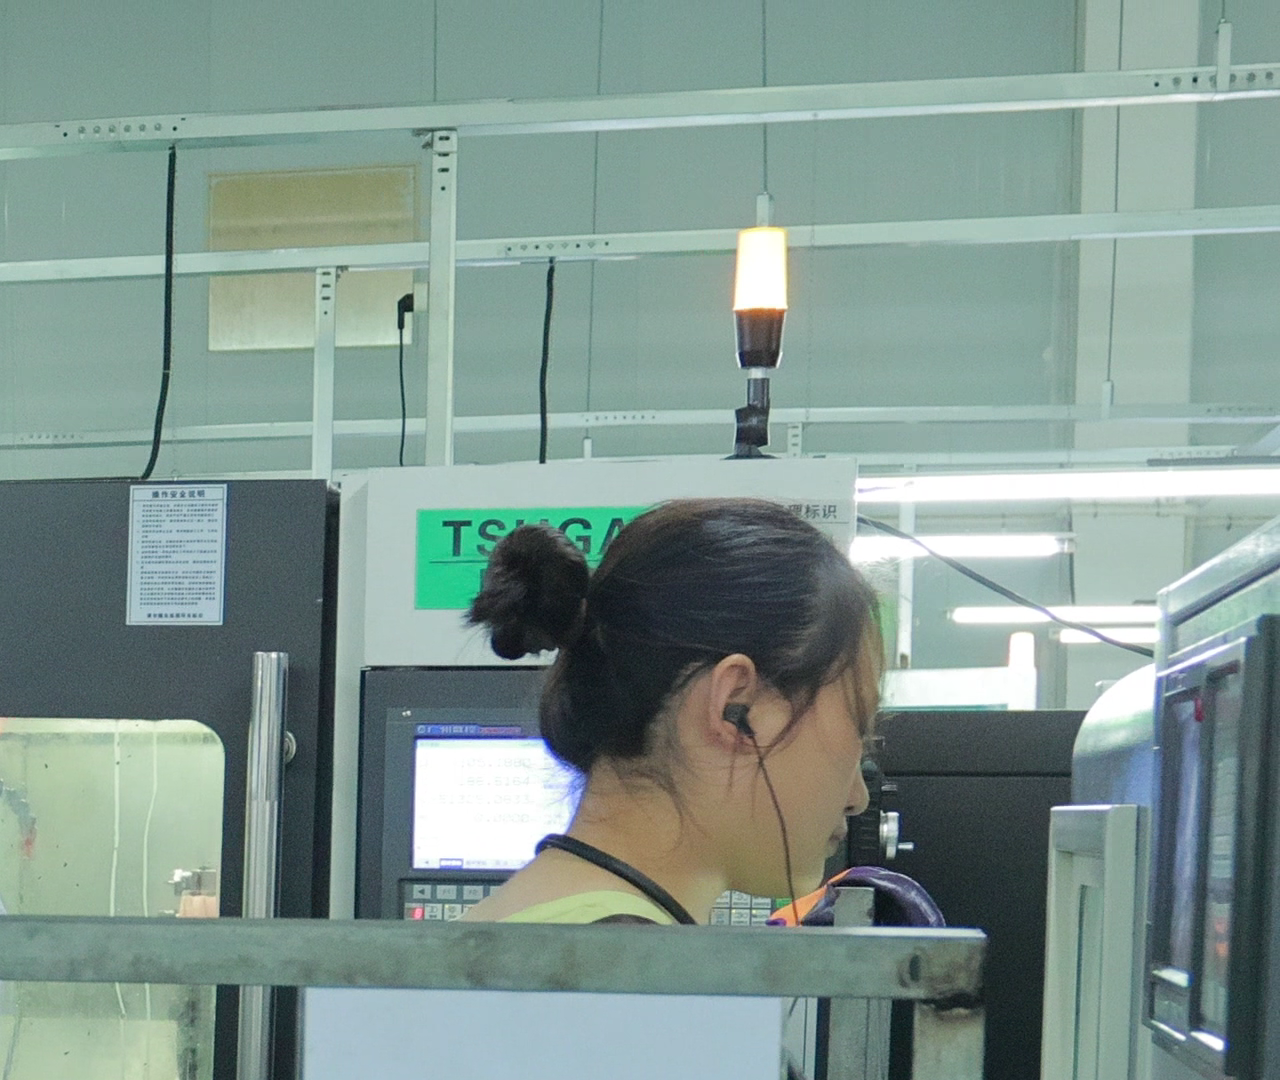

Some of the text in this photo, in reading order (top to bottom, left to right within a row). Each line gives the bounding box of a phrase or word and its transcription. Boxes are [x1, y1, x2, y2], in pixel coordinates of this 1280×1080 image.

[151, 489, 205, 499] 操作安全说明
